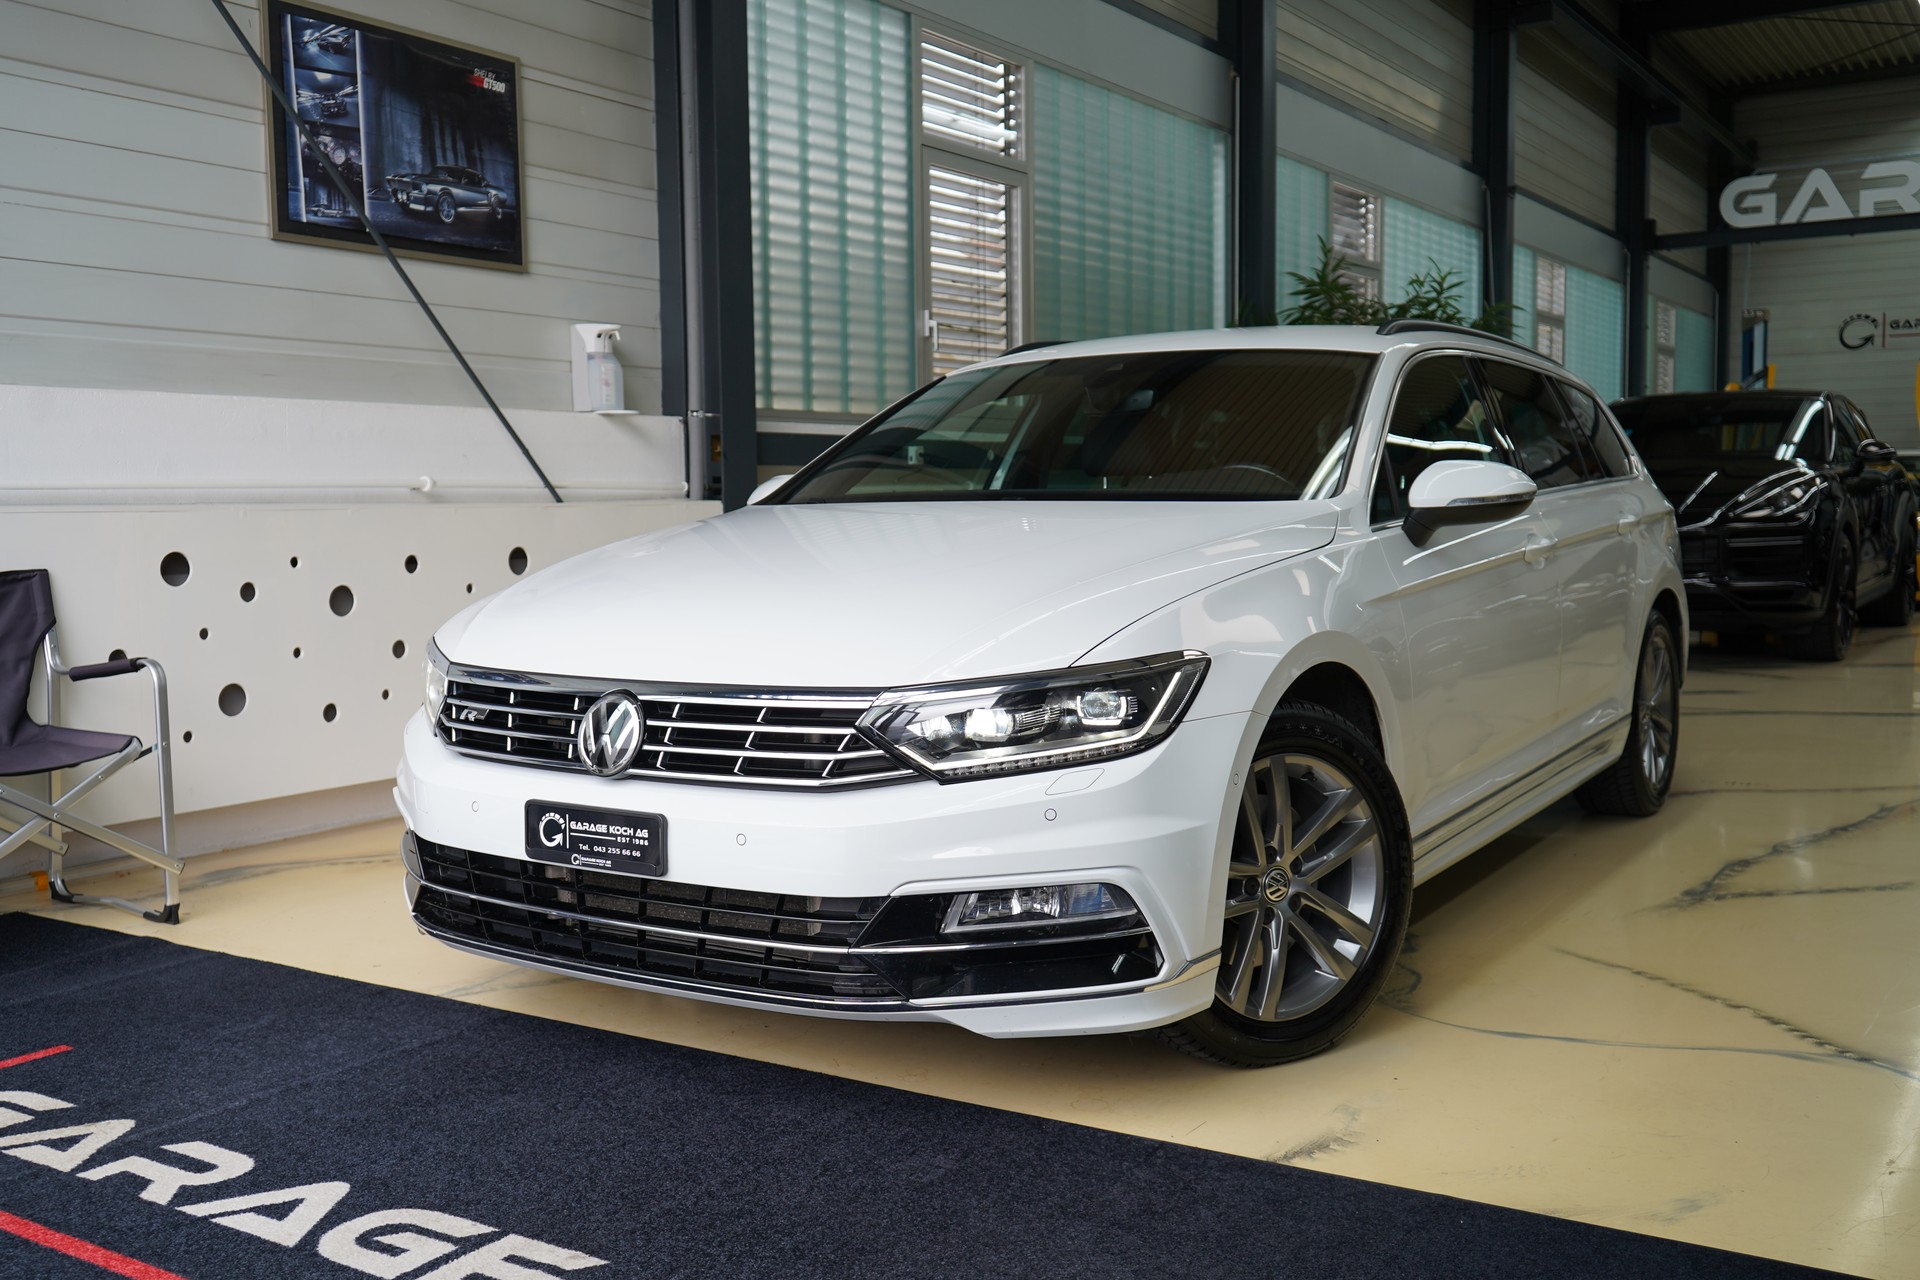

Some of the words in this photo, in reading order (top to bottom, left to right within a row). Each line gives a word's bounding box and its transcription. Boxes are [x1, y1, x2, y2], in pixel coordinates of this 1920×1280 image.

[474, 68, 496, 79] SHELBY
[484, 77, 506, 93] GT500
[1719, 160, 1920, 228] GAR
[569, 821, 608, 833] GARAGE
[609, 825, 634, 836] KOCH
[635, 828, 649, 838] AG
[578, 843, 591, 851] Tel.
[593, 845, 606, 853] 043
[607, 847, 620, 855] 255
[632, 838, 649, 846] 1986
